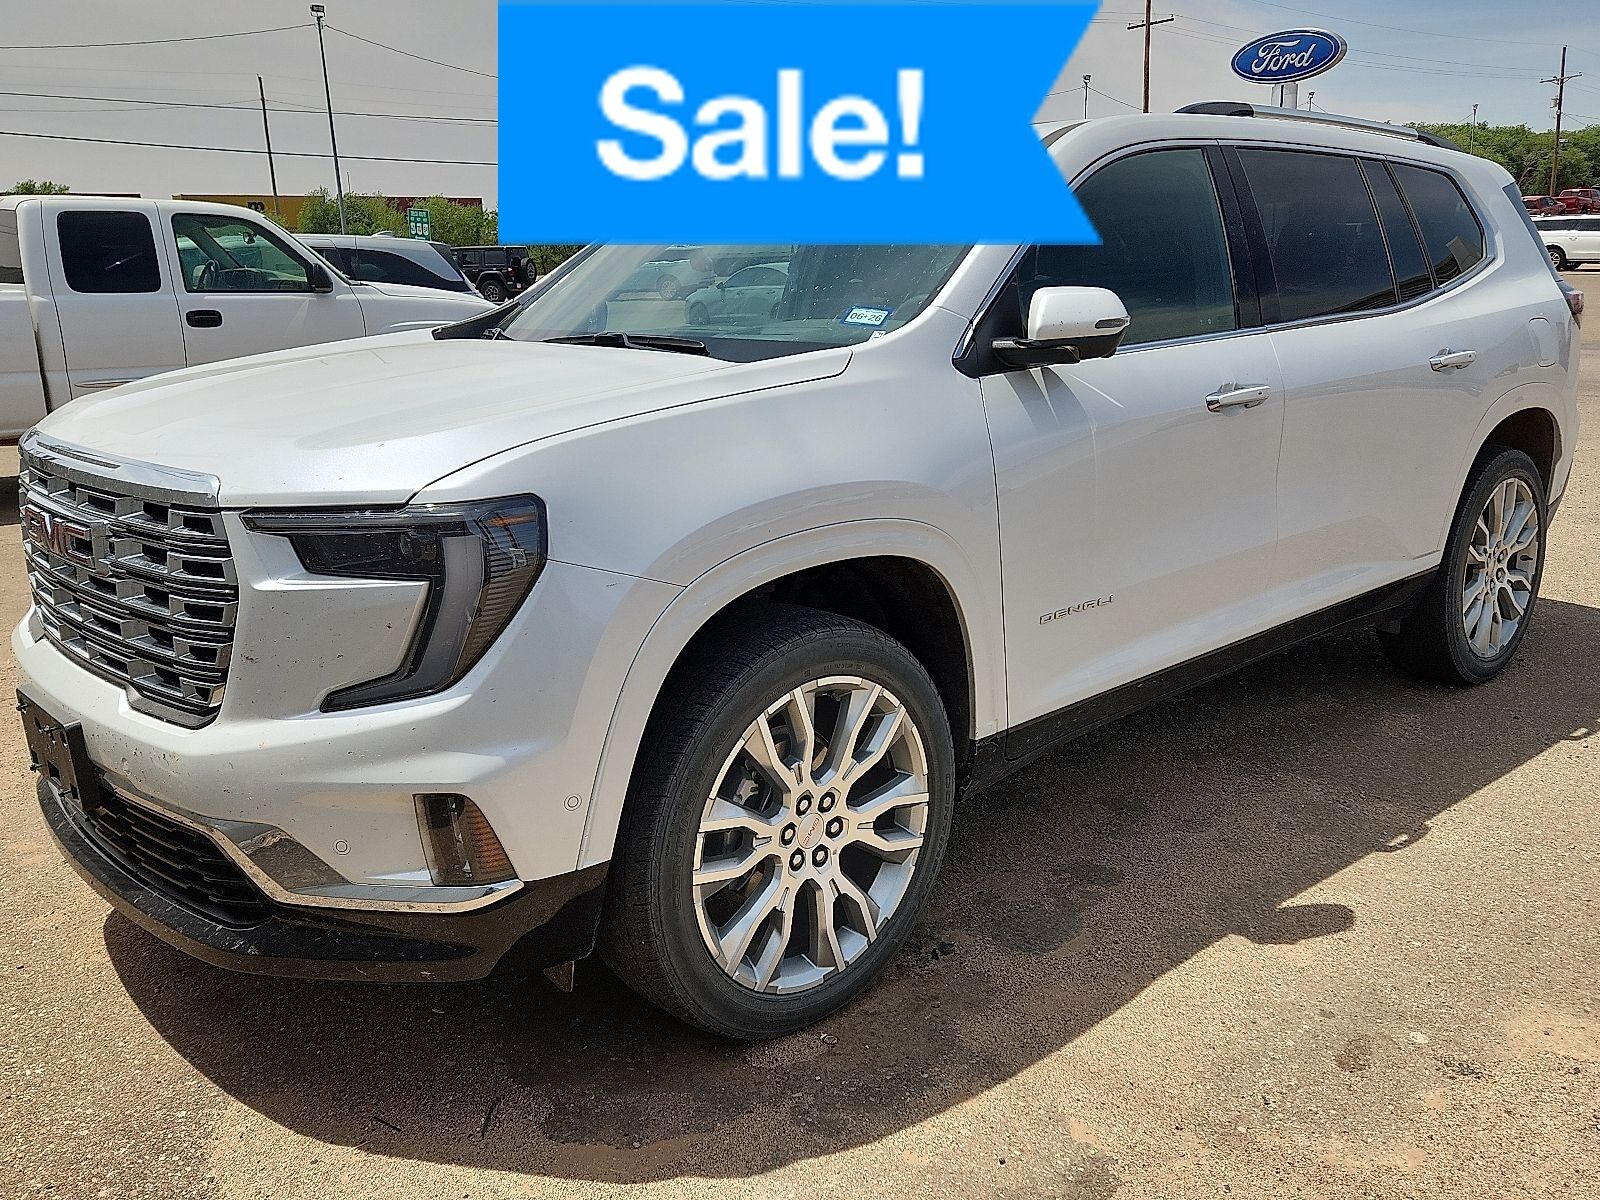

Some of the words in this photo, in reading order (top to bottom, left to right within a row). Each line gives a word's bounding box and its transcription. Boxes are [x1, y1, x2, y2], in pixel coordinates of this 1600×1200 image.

[1251, 39, 1317, 74] Ford
[21, 503, 97, 571] GMC
[1039, 594, 1114, 625] DENALI
